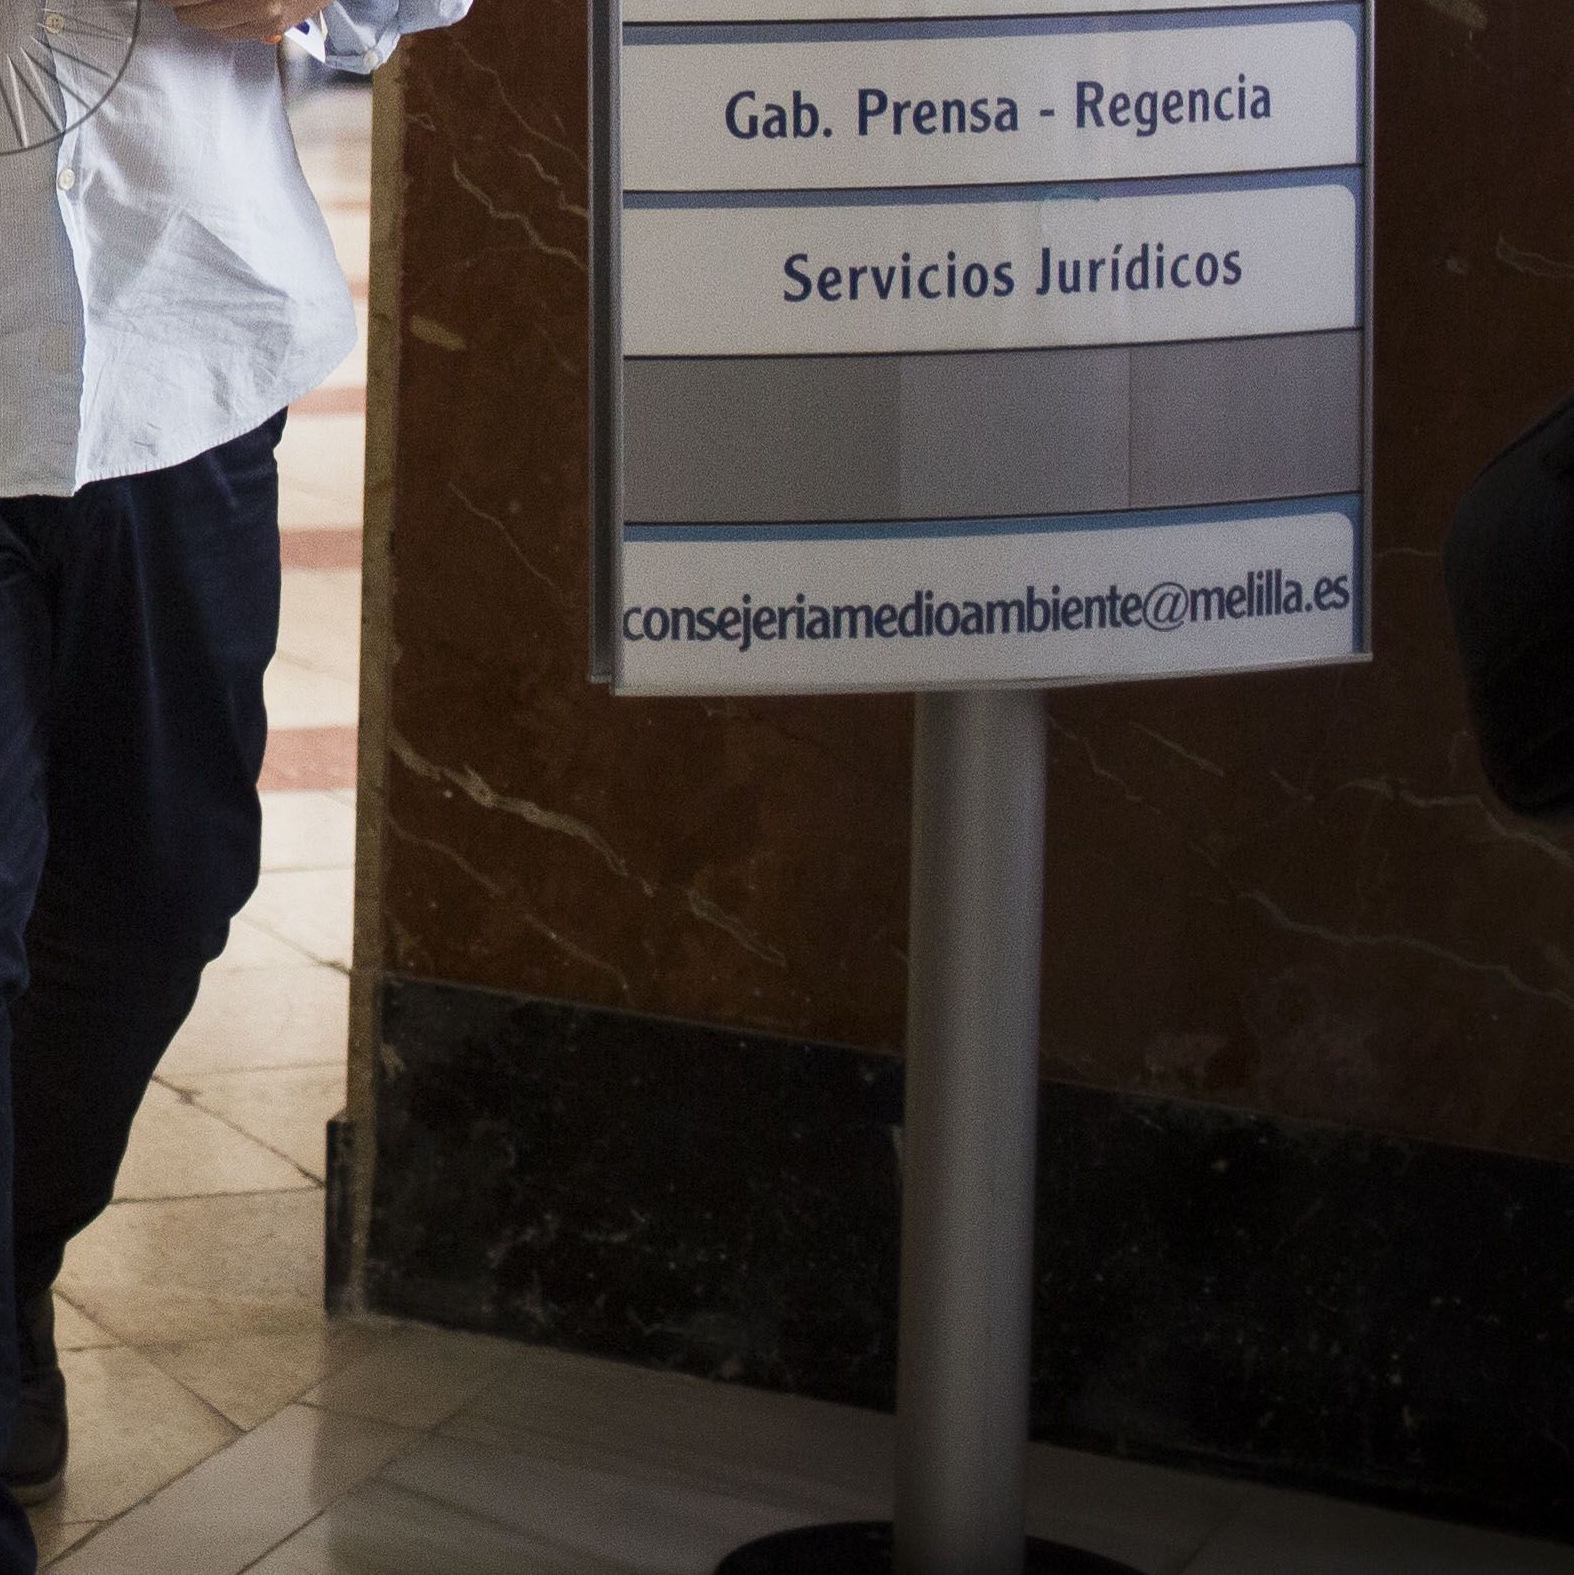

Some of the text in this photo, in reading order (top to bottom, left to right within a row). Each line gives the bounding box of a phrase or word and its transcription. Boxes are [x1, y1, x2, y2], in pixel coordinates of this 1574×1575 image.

[725, 73, 1271, 140] Gab. Prensa - Regencia
[783, 242, 1242, 303] Servicios Jurídicos
[622, 569, 1350, 652] consejeriamedioambiente@melilla.es
